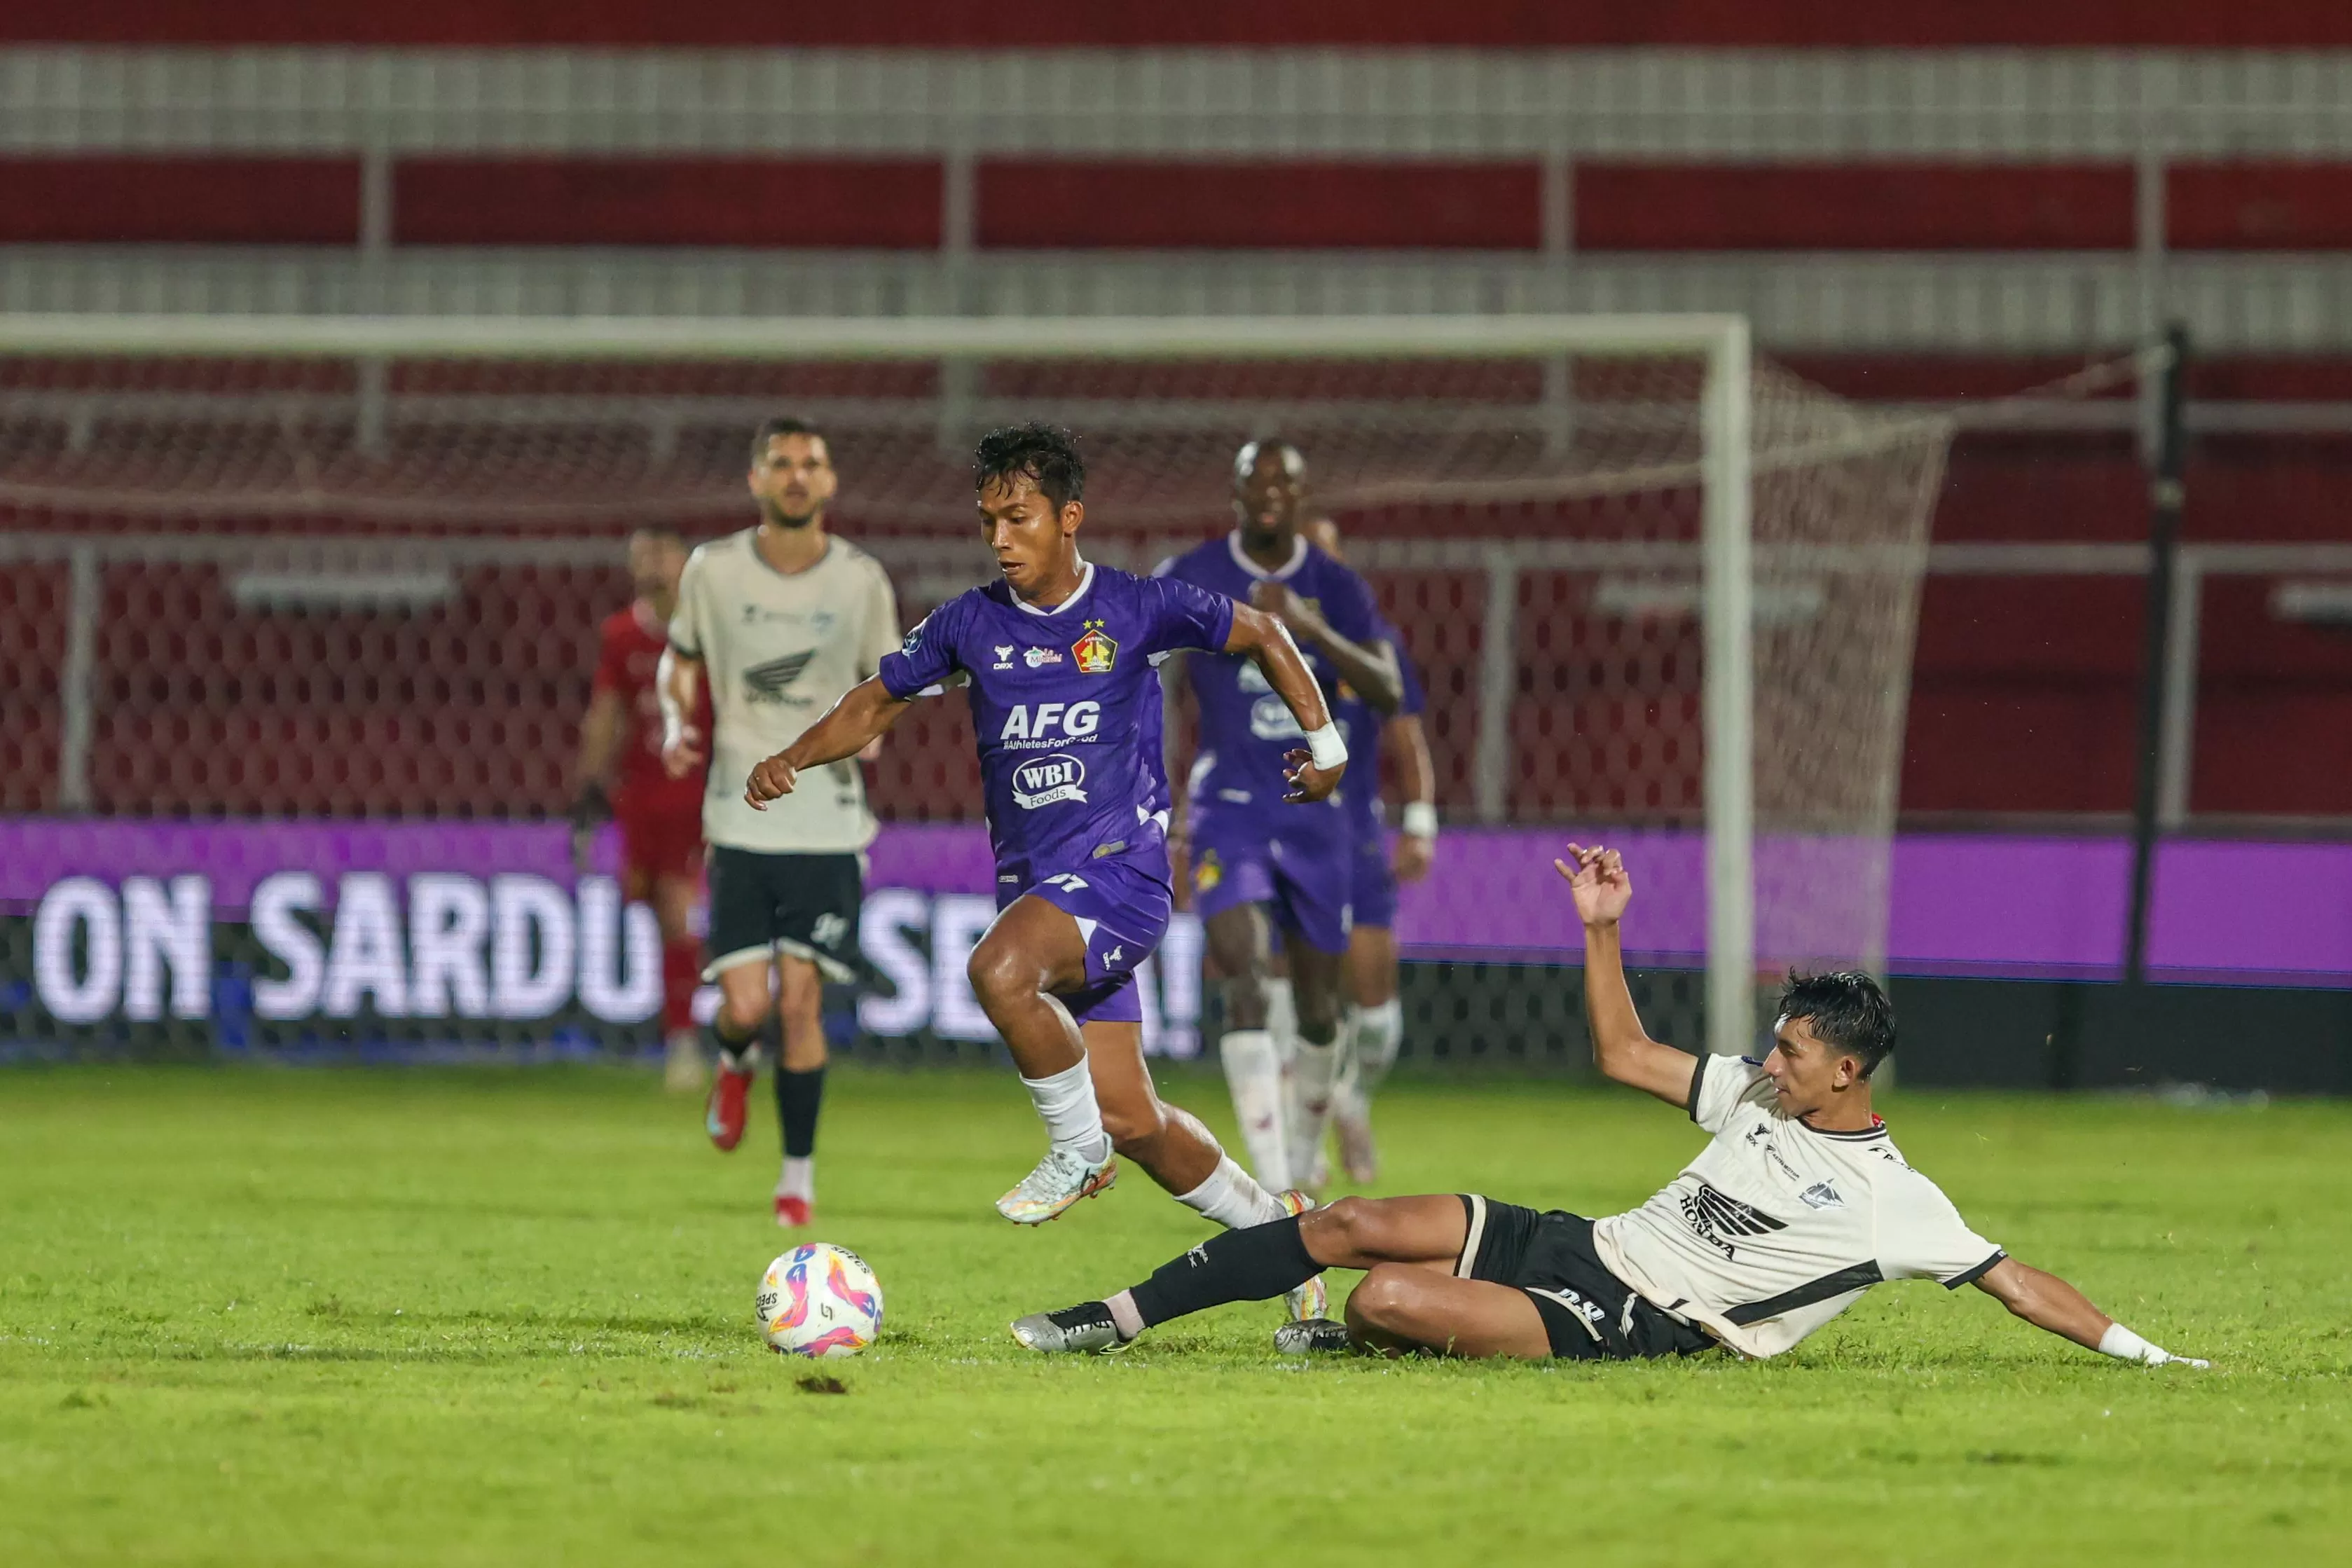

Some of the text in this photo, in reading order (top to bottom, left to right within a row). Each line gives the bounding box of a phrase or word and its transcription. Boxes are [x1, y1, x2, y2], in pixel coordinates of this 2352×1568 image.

[1000, 701, 1101, 740] AFG
[1022, 762, 1073, 789] WBI
[1029, 789, 1066, 807] Foods
[33, 875, 212, 1022] ON
[1679, 1193, 1735, 1261] HONDA
